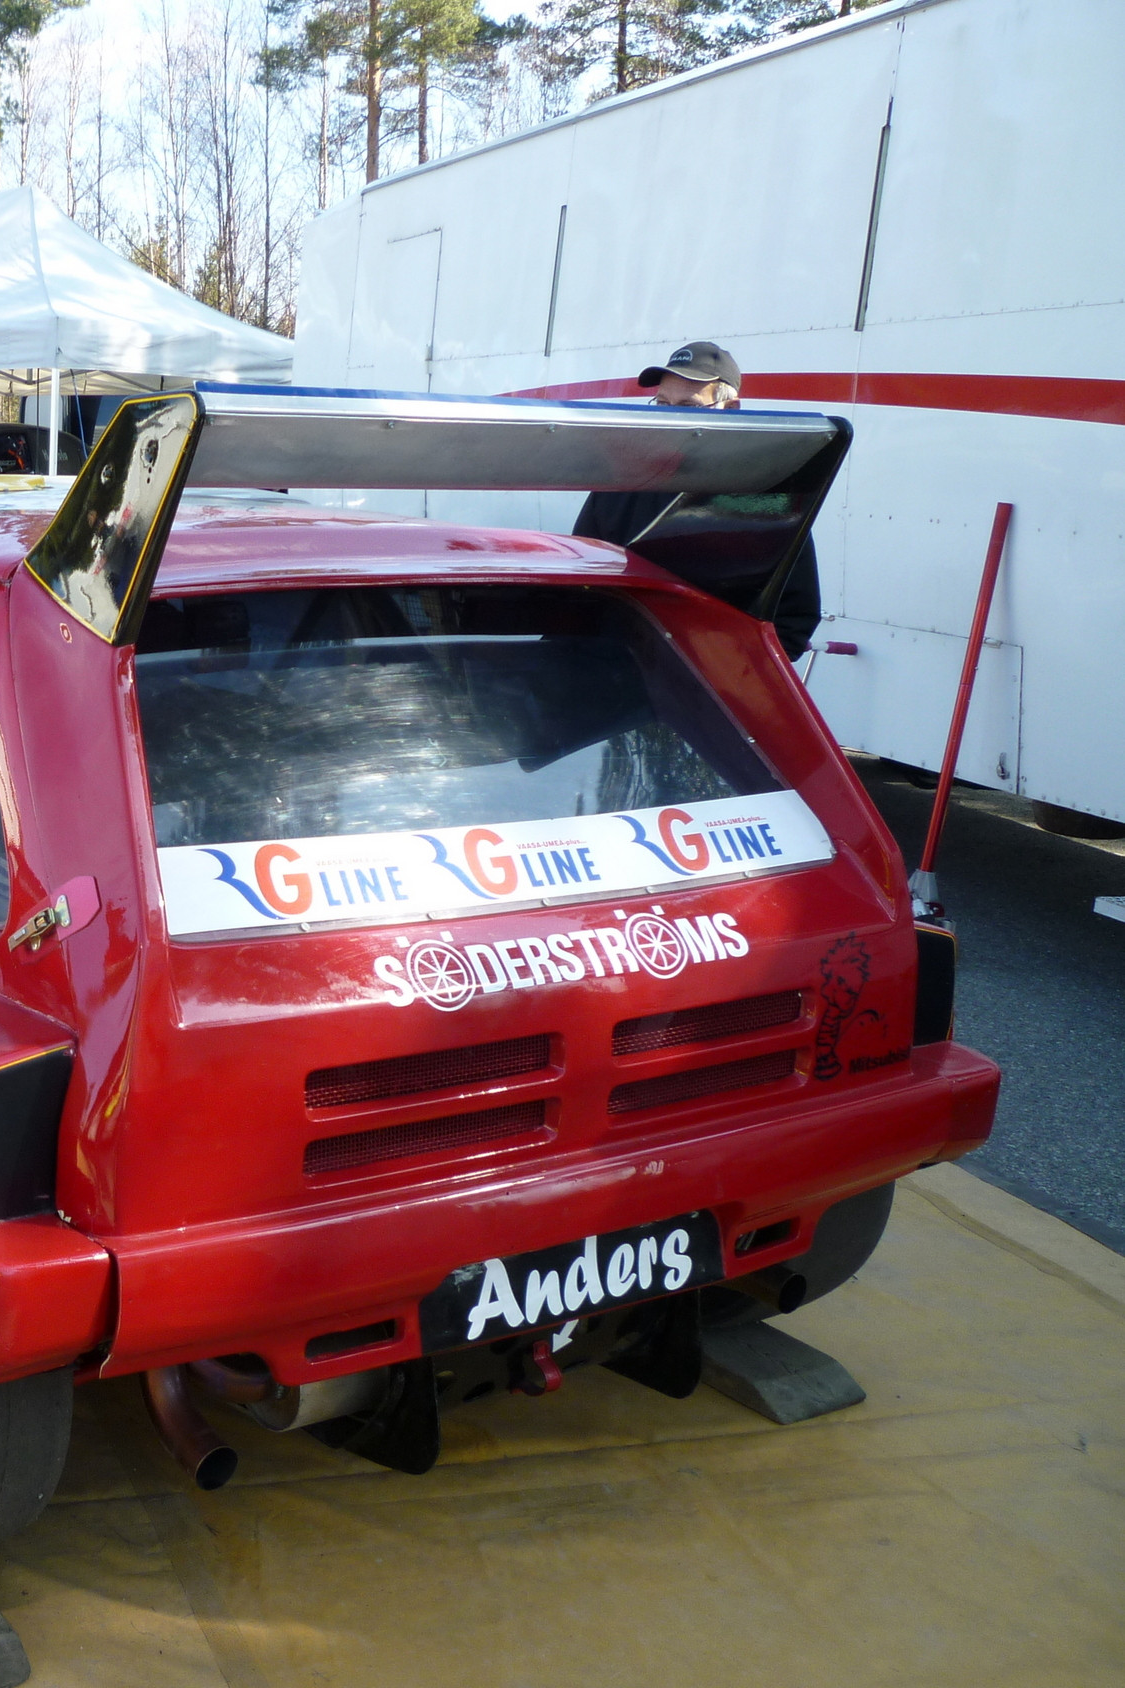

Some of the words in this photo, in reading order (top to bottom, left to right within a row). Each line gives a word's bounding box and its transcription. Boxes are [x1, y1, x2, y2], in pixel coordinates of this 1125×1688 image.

[709, 823, 782, 863] LINE
[320, 866, 409, 906] LINE
[520, 847, 601, 887] LINE
[374, 905, 749, 1012] SÖDERSTRÖMS
[467, 1229, 693, 1341] Anders
